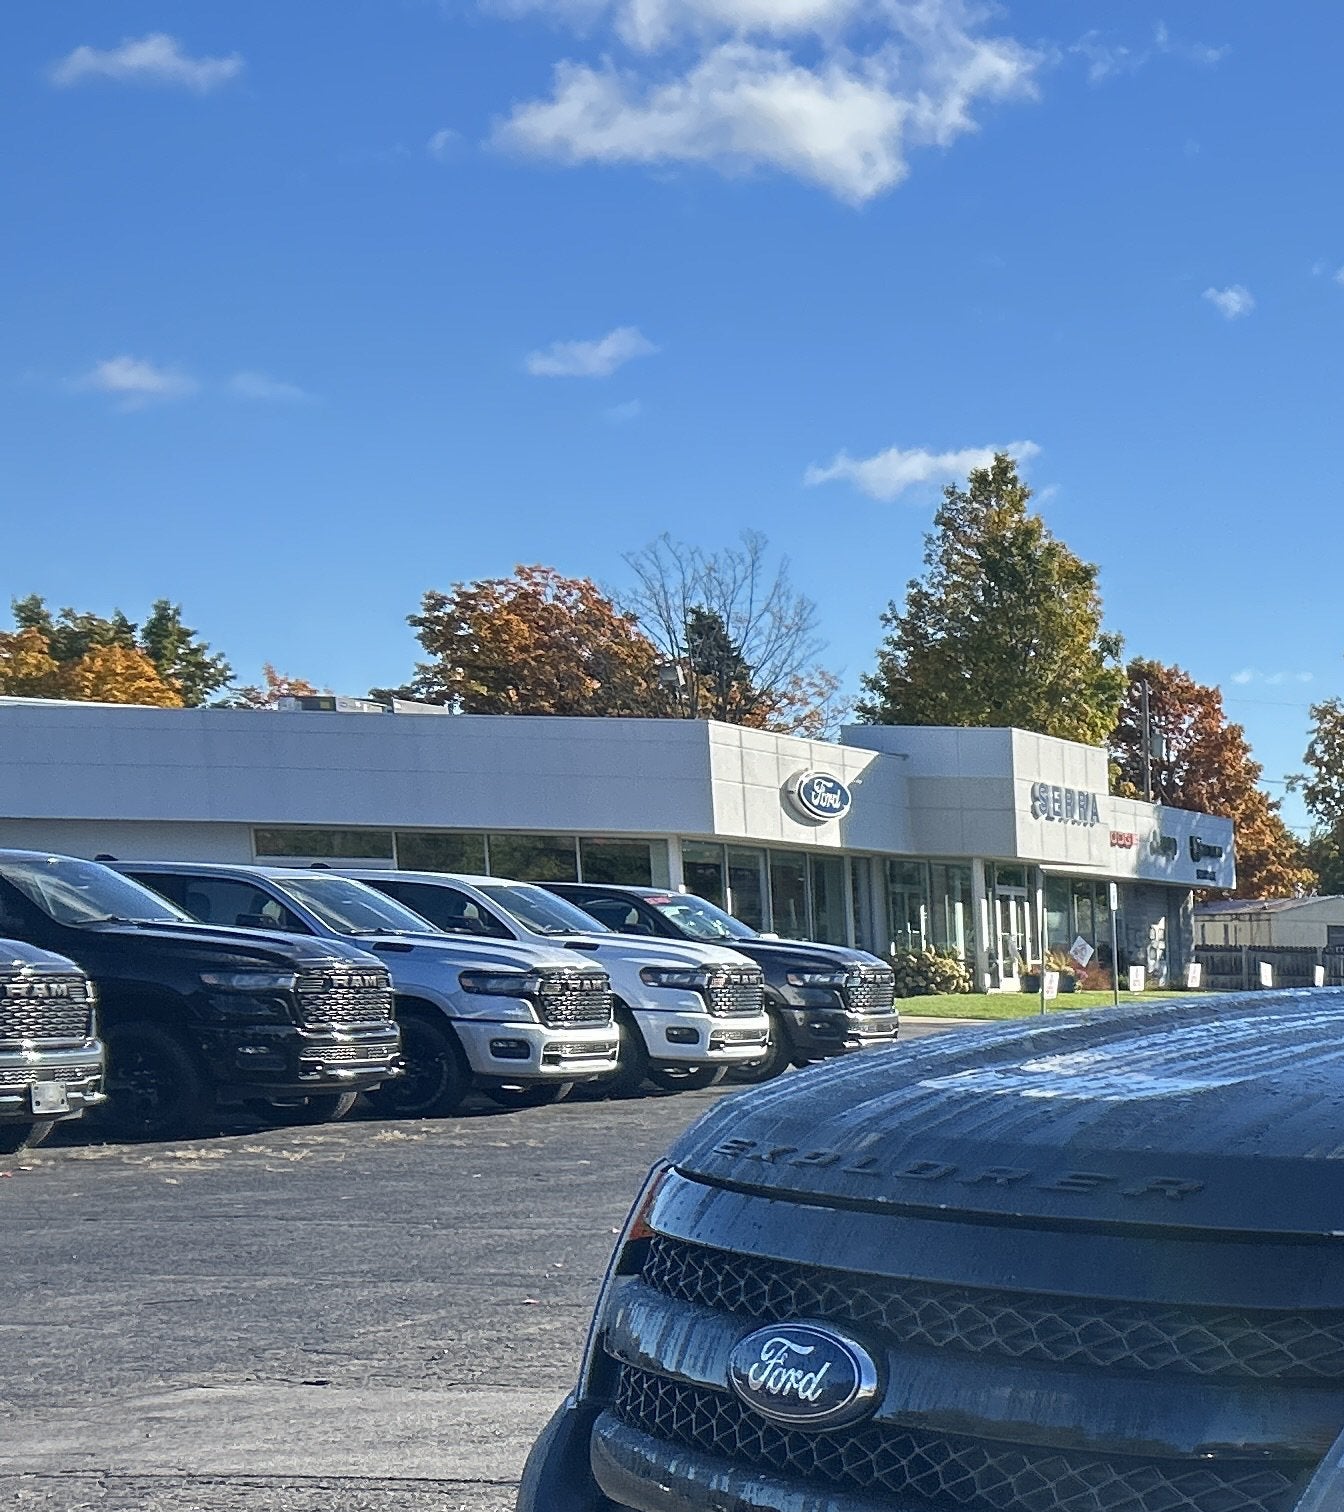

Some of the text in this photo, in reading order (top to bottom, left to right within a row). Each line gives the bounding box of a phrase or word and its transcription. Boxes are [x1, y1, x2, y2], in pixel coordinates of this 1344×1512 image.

[811, 778, 841, 809] Ford
[1031, 782, 1100, 826] SERRA
[4, 983, 69, 998] RAM
[331, 975, 378, 988] RAM
[713, 1138, 1204, 1199] EXPLORER
[748, 1336, 829, 1402] Ford
